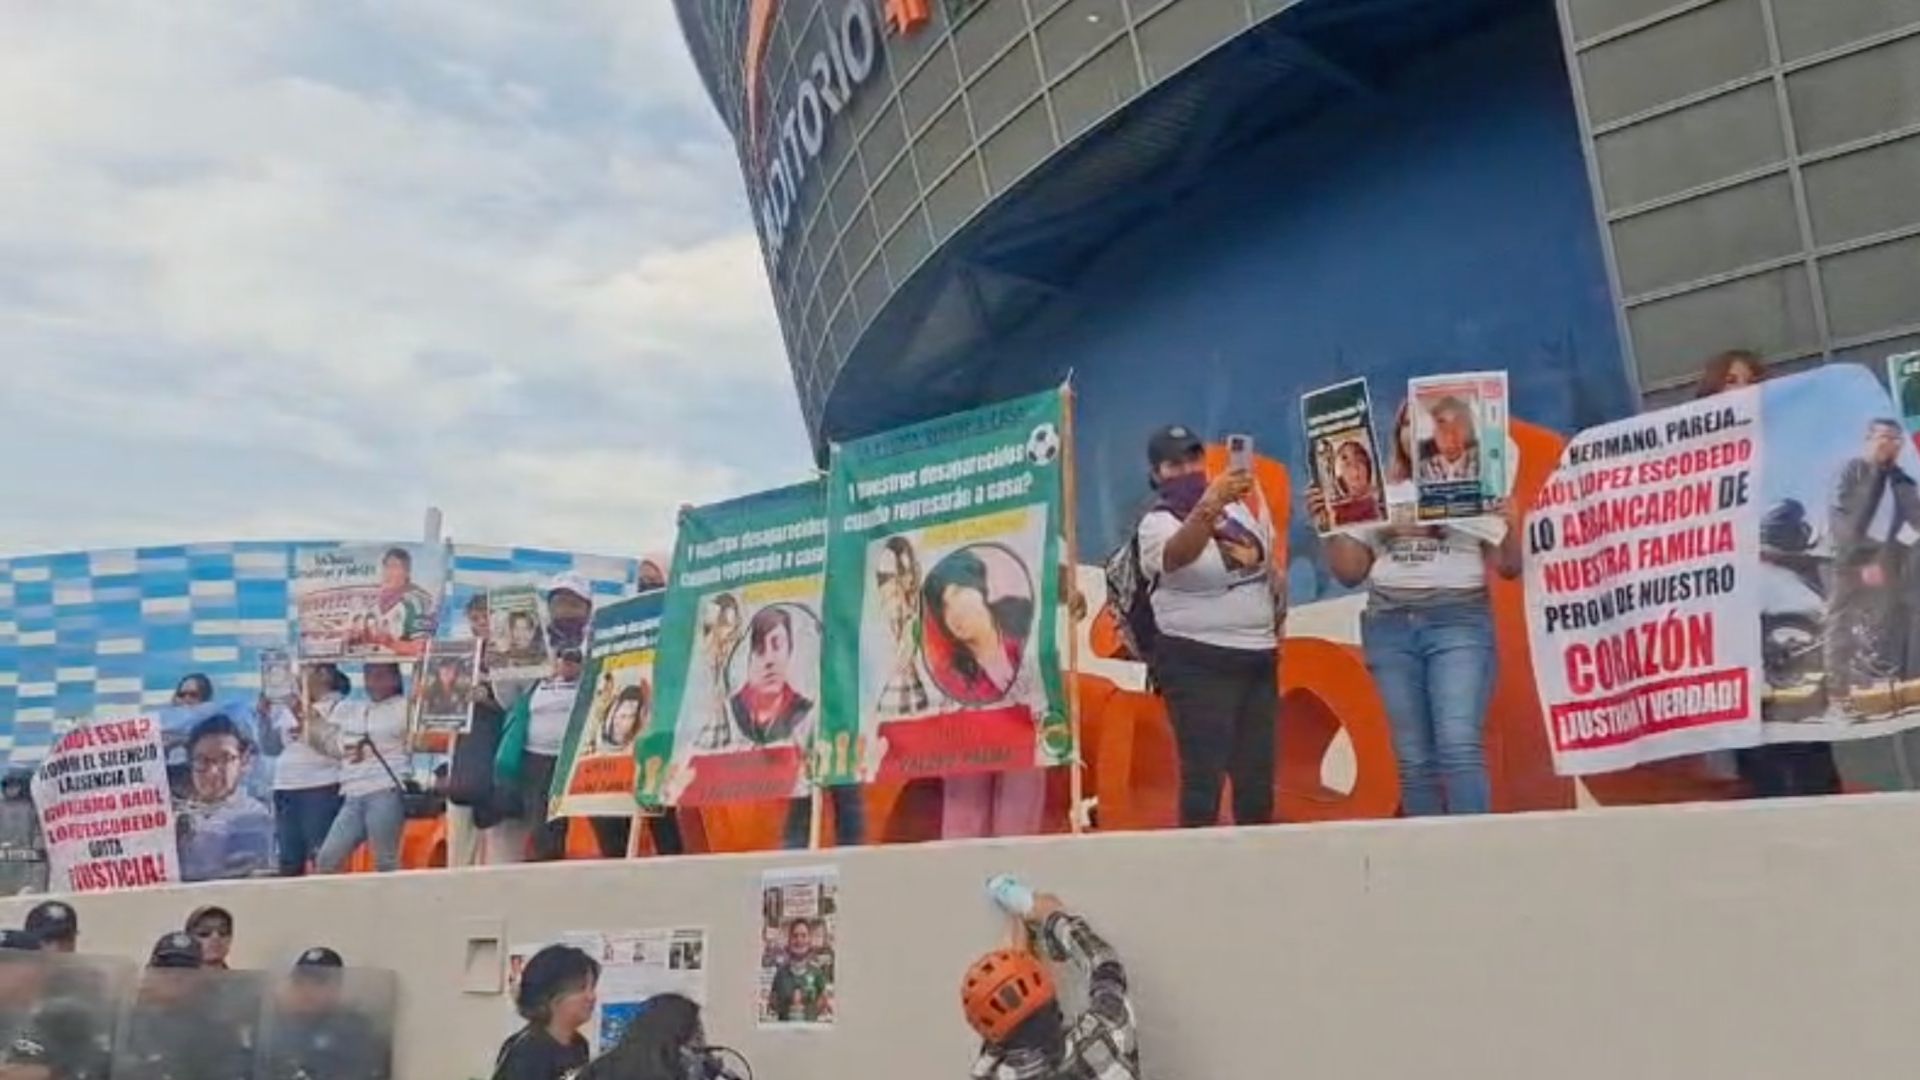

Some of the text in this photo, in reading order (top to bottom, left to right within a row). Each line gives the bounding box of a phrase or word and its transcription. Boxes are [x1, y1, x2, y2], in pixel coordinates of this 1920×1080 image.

[918, 444, 1025, 487] desaparecidos
[975, 484, 984, 504] a
[986, 471, 1034, 501] casa?
[1638, 439, 1753, 484] ESCOBEDO
[1530, 517, 1555, 554] LO
[1719, 471, 1750, 510] DE
[1543, 522, 1735, 593] NUESTRA FAMILIA
[1544, 600, 1599, 633] PERO
[1616, 584, 1634, 614] DE
[1639, 564, 1735, 608] NUESTRO
[1564, 609, 1714, 696] CORAZÓN
[1650, 678, 1743, 721] VERDAD!
